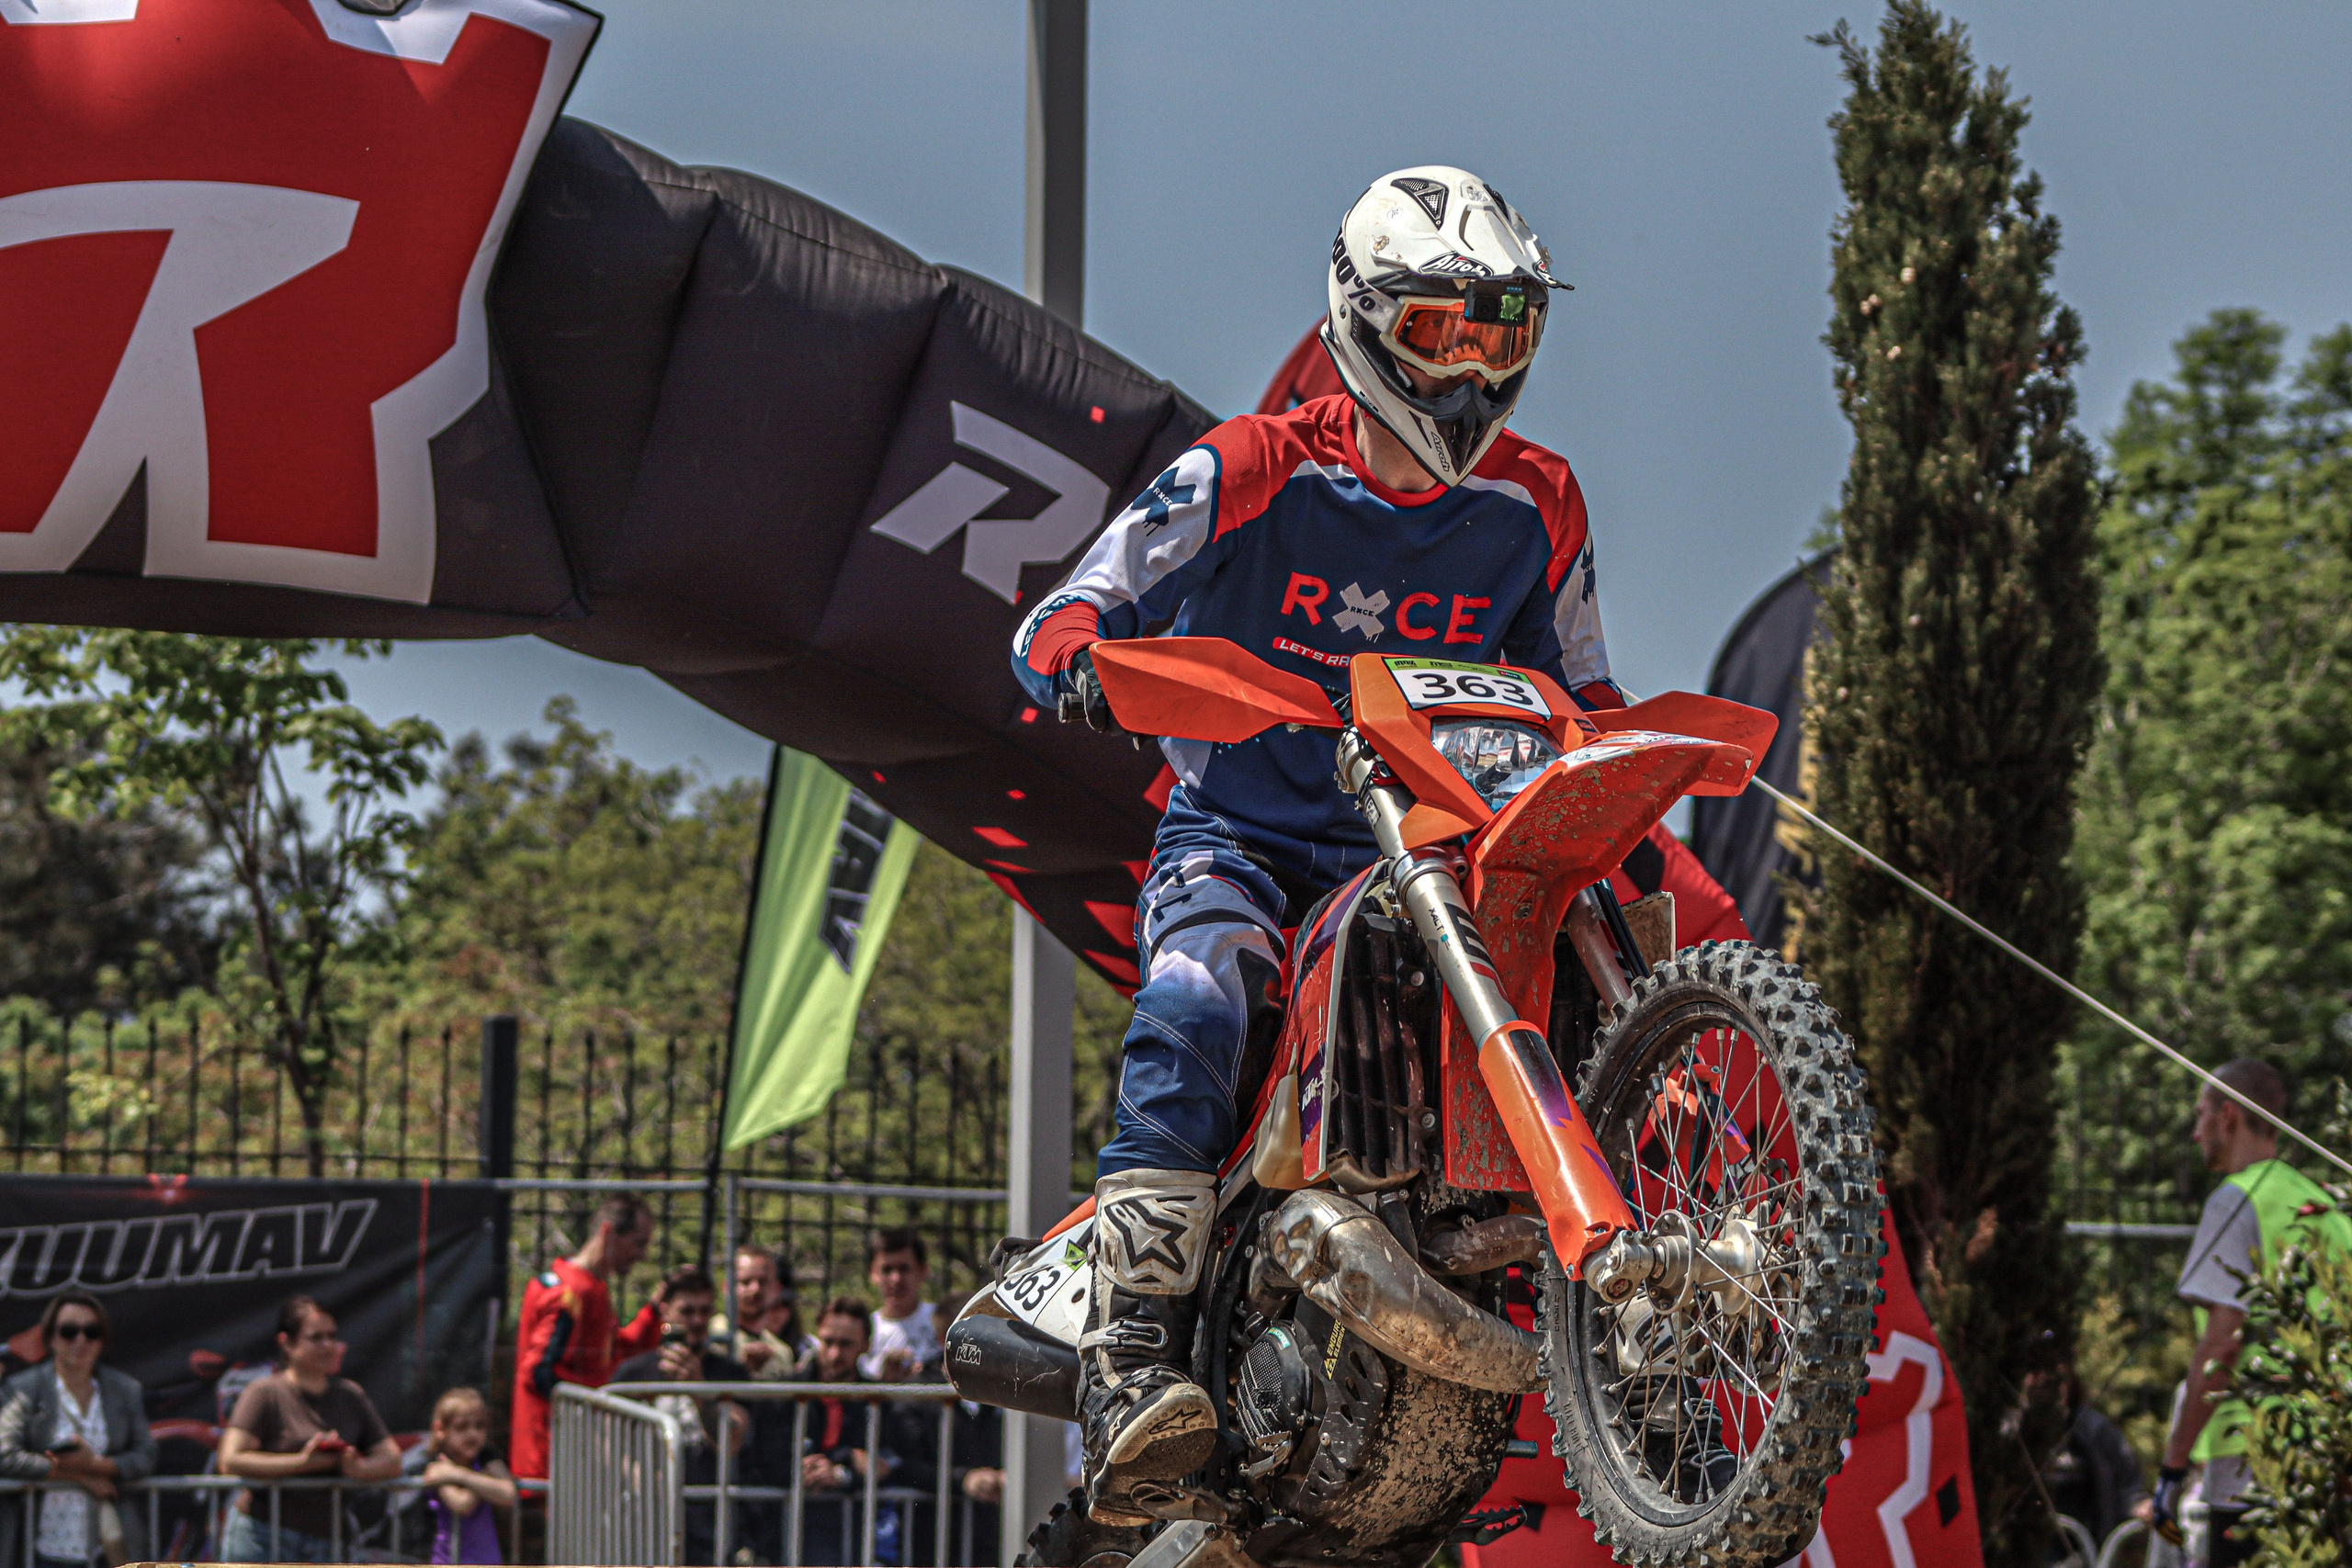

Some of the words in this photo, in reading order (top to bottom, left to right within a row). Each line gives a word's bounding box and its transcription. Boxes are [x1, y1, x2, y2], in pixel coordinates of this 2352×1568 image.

[1430, 431, 1451, 472] Airoh
[1279, 638, 1325, 661] LET'S
[1326, 655, 1351, 666] RA
[1412, 672, 1534, 705] 363
[0, 1198, 379, 1298] UUMAV
[956, 1343, 982, 1365] KTM
[1333, 1324, 1347, 1358] ELEMEN
